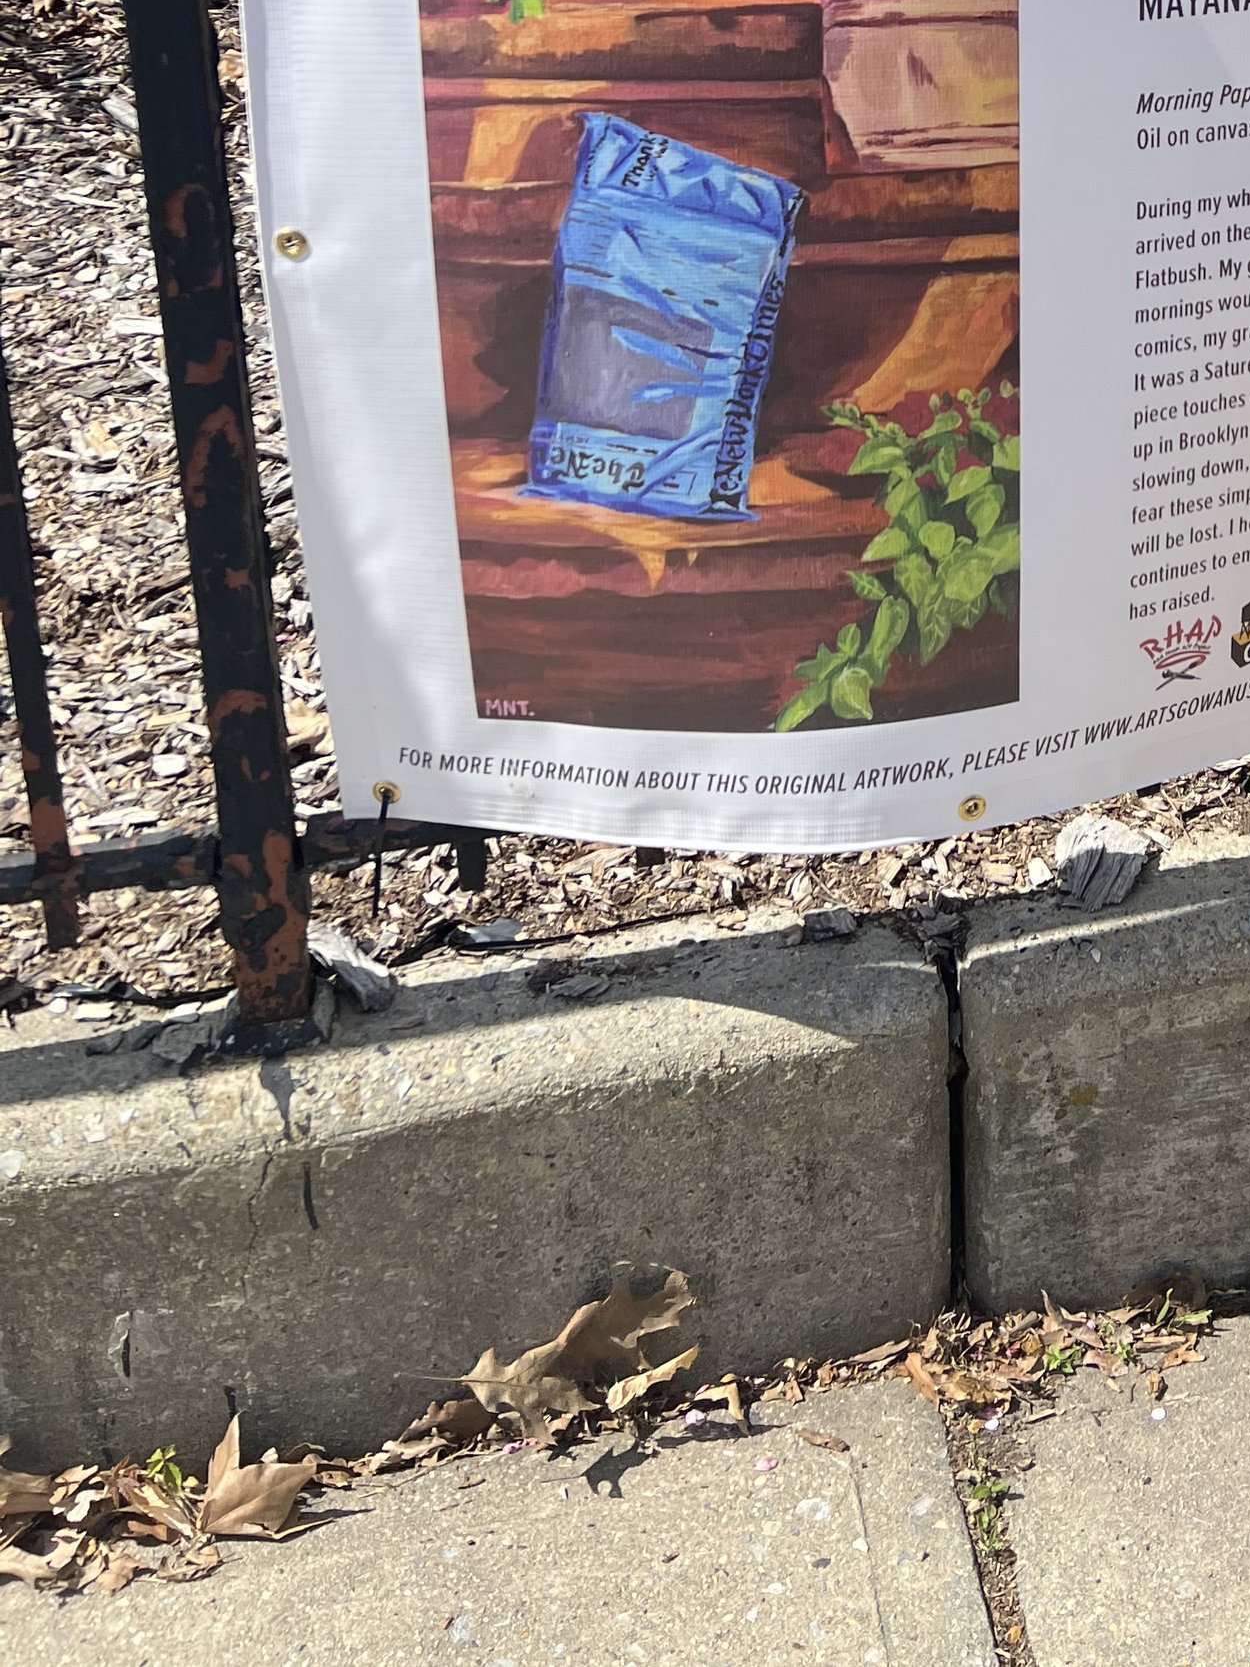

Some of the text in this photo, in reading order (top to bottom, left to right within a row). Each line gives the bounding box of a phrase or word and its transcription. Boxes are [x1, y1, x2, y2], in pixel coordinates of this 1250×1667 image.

[1136, 88, 1214, 114] Morning
[1137, 127, 1160, 150] Oil
[1167, 129, 1189, 146] on
[1137, 198, 1191, 220] During
[1198, 196, 1221, 216] my
[1136, 229, 1195, 255] arrived
[1201, 231, 1220, 246] on
[1136, 263, 1212, 289] Flatbush.
[1219, 258, 1242, 280] My
[1135, 299, 1213, 323] mornings
[1135, 334, 1197, 357] comics,
[1204, 331, 1227, 350] my
[1135, 373, 1145, 391] It
[1151, 371, 1184, 389] was
[1190, 369, 1198, 383] a
[1134, 405, 1177, 429] piece
[1184, 393, 1245, 417] touches
[1134, 443, 1153, 461] up
[1159, 436, 1173, 454] in
[1133, 467, 1195, 491] slowing
[1201, 458, 1249, 478] down,
[1132, 506, 1164, 524] fear
[1170, 496, 1213, 517] these
[1131, 534, 1160, 556] will
[1166, 532, 1184, 549] be
[1190, 523, 1222, 544] lost.
[1230, 518, 1233, 535] I
[1130, 560, 1206, 588] continues
[1212, 554, 1227, 570] to
[1130, 585, 1214, 620] has raised.
[485, 698, 536, 717] MNT.
[399, 747, 432, 769] FOR
[439, 754, 493, 774] MORE
[500, 758, 629, 787] INFORMATION
[634, 771, 700, 790] ABOUT
[707, 774, 748, 794] THIS
[755, 772, 846, 794] ORIGINAL
[853, 757, 953, 790] ARTWORK,
[962, 741, 1030, 774] PLEASE
[1036, 729, 1080, 757] VISIT
